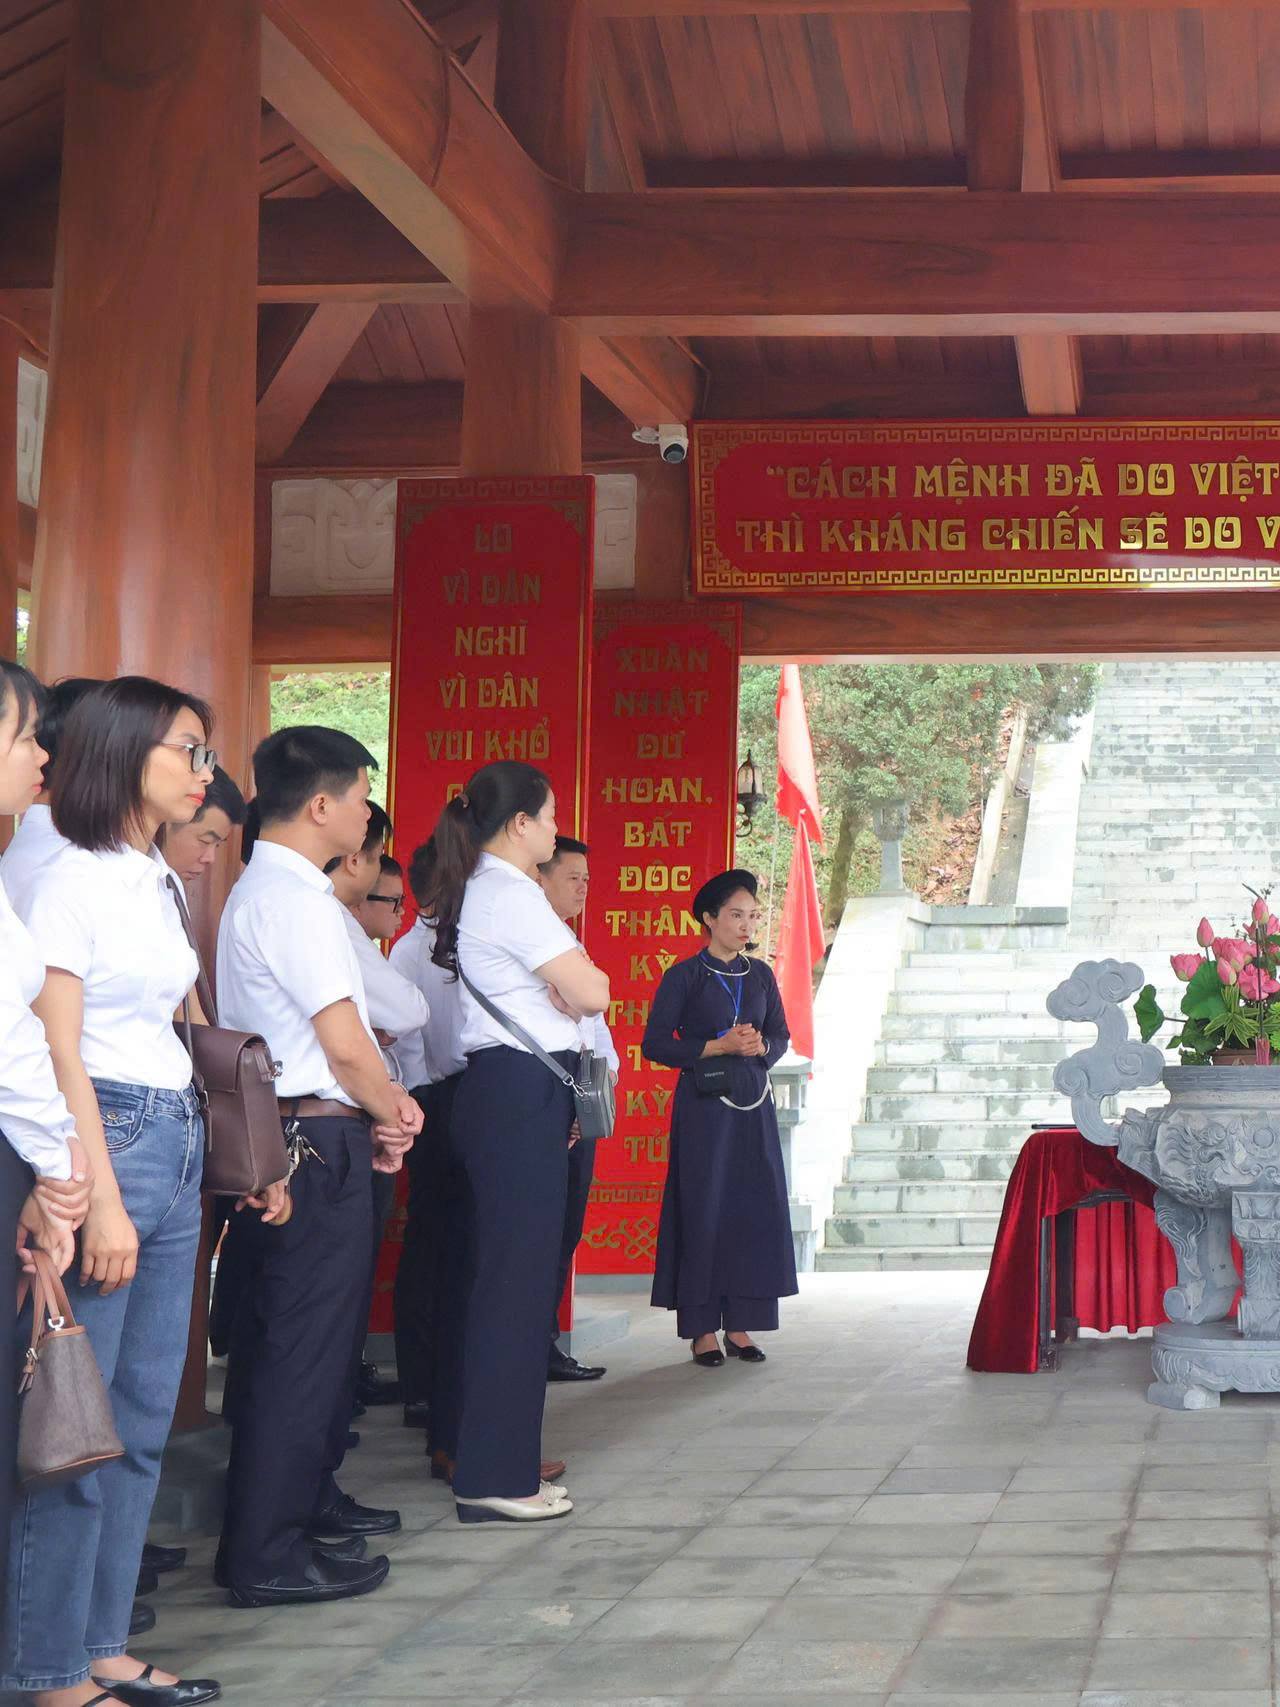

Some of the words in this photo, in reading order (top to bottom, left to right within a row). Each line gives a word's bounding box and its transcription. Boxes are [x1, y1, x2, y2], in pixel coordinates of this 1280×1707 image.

[914, 457, 1030, 505] MỆNH
[1045, 456, 1103, 497] ĐÃ
[1117, 463, 1176, 496] DO
[1190, 455, 1280, 502] VIỆT
[735, 512, 805, 553] THÌ
[819, 511, 967, 552] KHÁNG
[982, 504, 1104, 551] CHIẾN
[1119, 511, 1169, 550] SẼ
[1183, 516, 1242, 550] DO
[441, 568, 471, 605] VÌ
[482, 567, 542, 606] DÂN
[616, 641, 711, 673] XUÂN
[439, 671, 467, 708] VÌ
[477, 671, 540, 708] DÂN
[613, 684, 711, 723] NHẬT
[425, 729, 473, 761] VUI
[483, 716, 551, 760] KHỔ
[623, 810, 692, 848] BẤT
[605, 904, 703, 937] THÂN
[625, 1083, 673, 1117] KỲ
